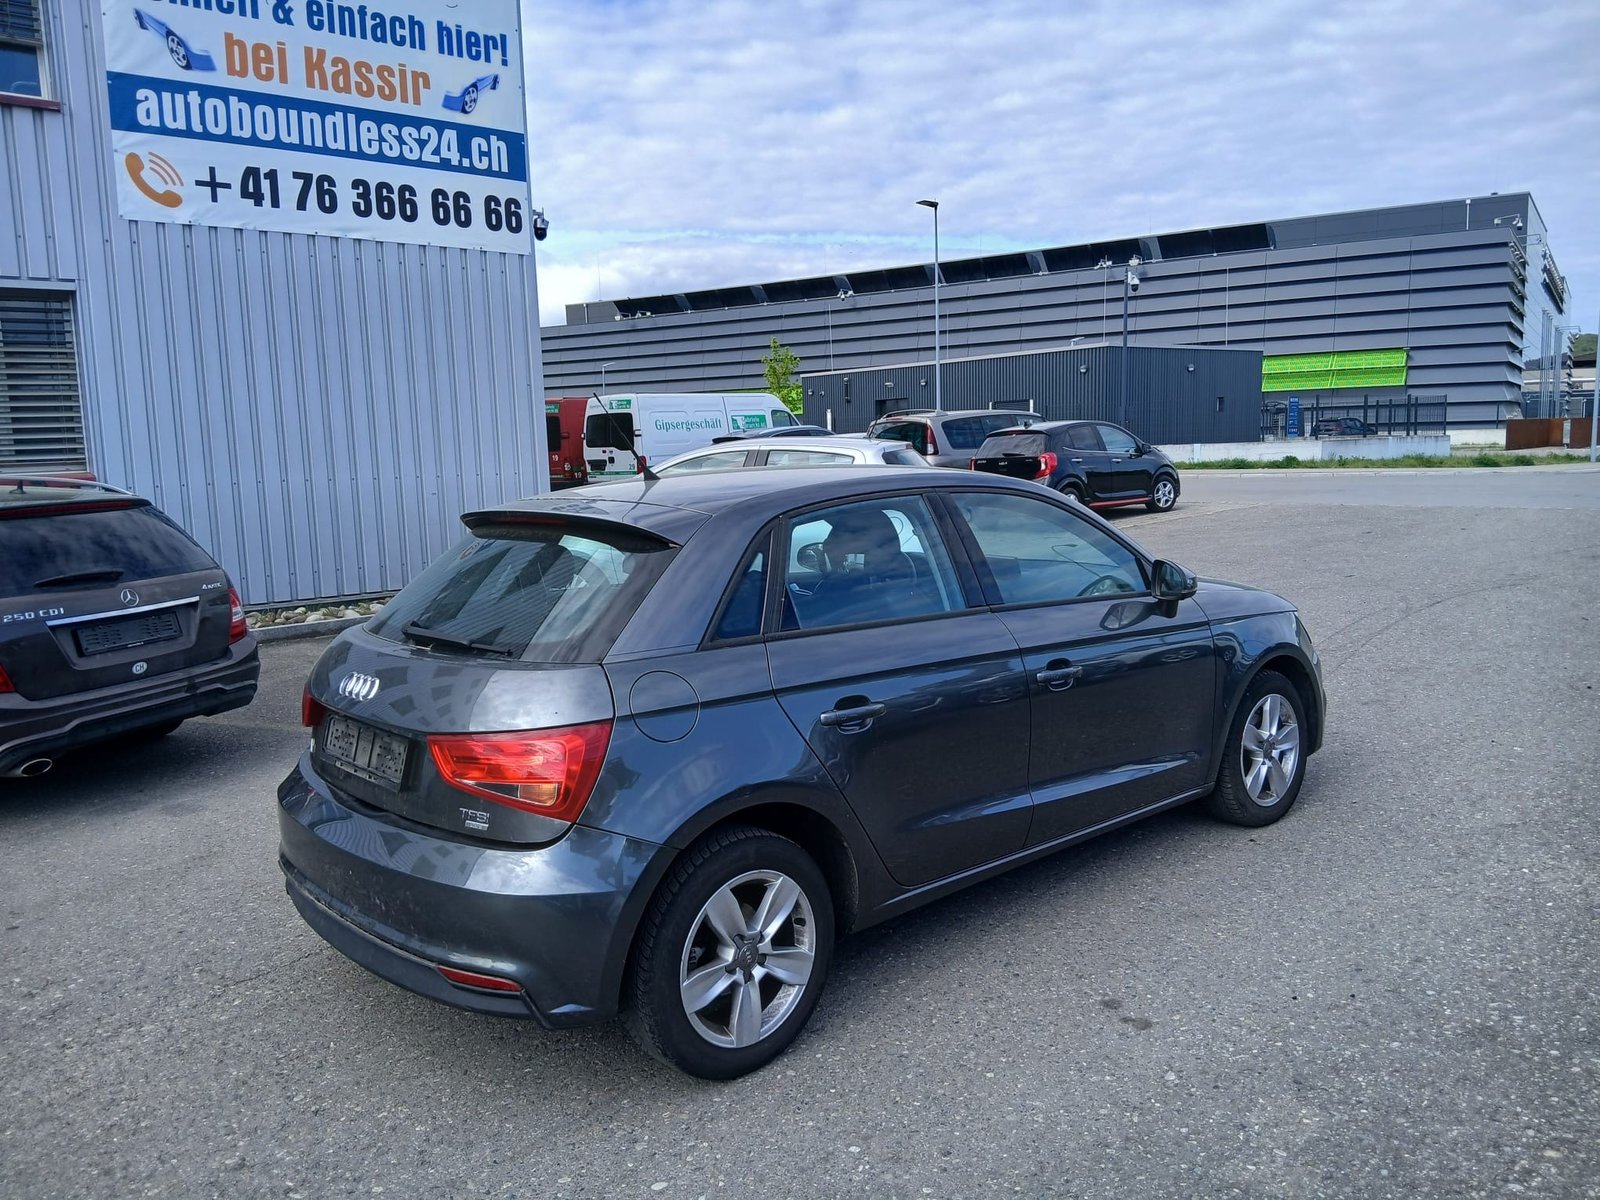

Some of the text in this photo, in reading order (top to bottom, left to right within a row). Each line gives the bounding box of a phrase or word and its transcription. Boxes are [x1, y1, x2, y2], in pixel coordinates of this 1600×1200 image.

[272, 0, 295, 26] &
[306, 0, 426, 51] einfach
[437, 20, 509, 67] hier!
[224, 32, 431, 106] bei Kassir
[135, 87, 509, 173] autoboundless24.ch
[240, 166, 281, 209] 41
[292, 170, 338, 214] 76
[351, 178, 418, 223] 366
[431, 188, 472, 228] 66
[484, 194, 523, 234] 66
[654, 417, 723, 433] Gipsergeschäft
[3, 607, 65, 623] 250 CDI
[135, 663, 145, 673] CH
[459, 807, 490, 824] TFSI
